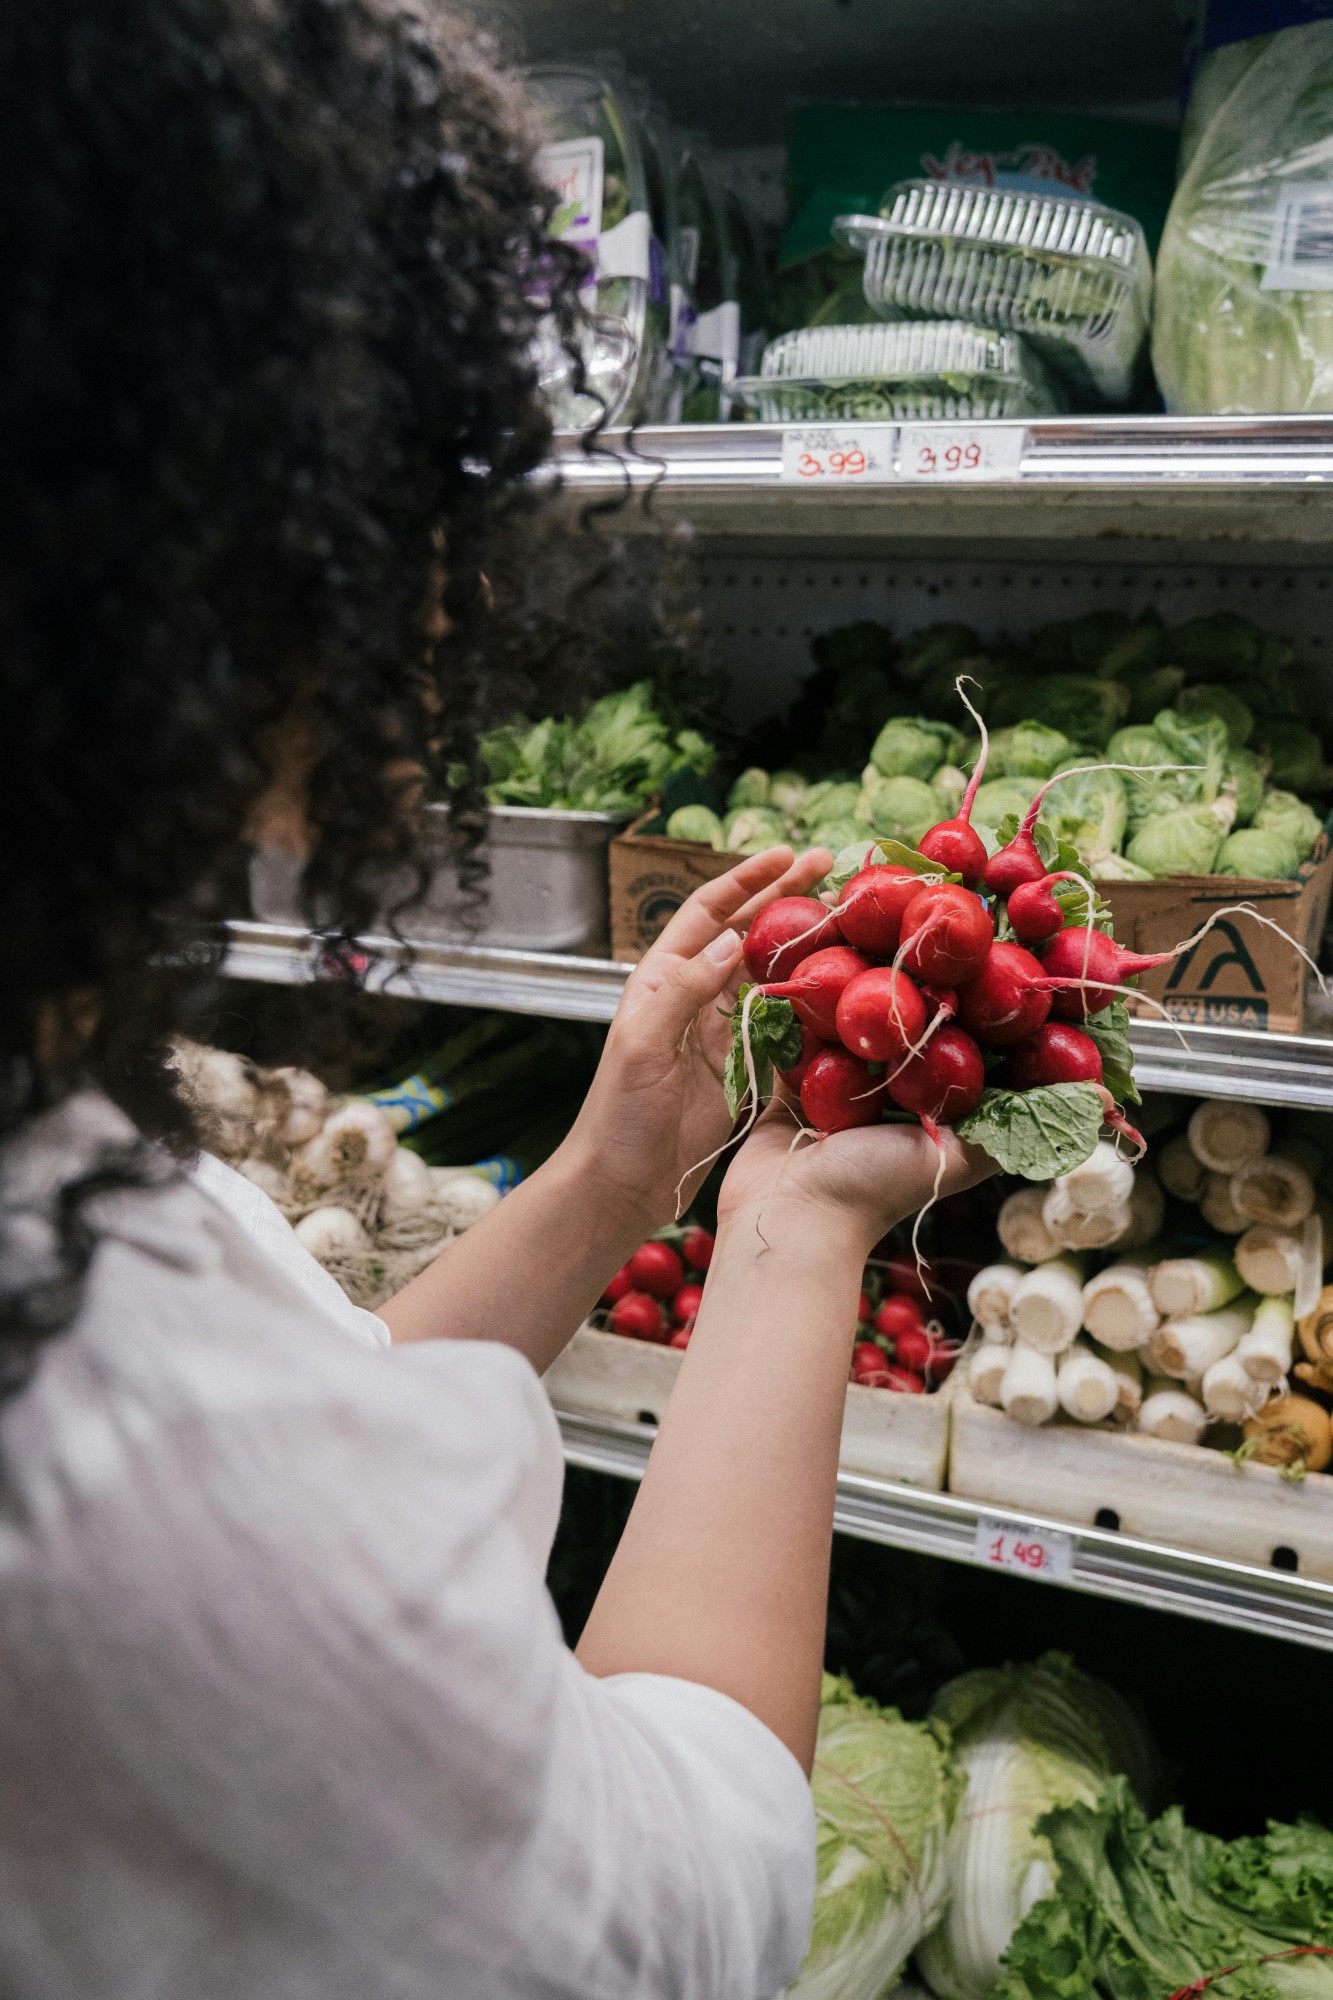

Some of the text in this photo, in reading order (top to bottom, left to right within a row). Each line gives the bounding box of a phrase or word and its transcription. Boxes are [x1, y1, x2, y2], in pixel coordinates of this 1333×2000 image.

[798, 450, 865, 477] 3.99
[918, 443, 981, 473] 3.99
[1209, 1003, 1259, 1023] USA
[989, 1536, 1044, 1568] 1.49
